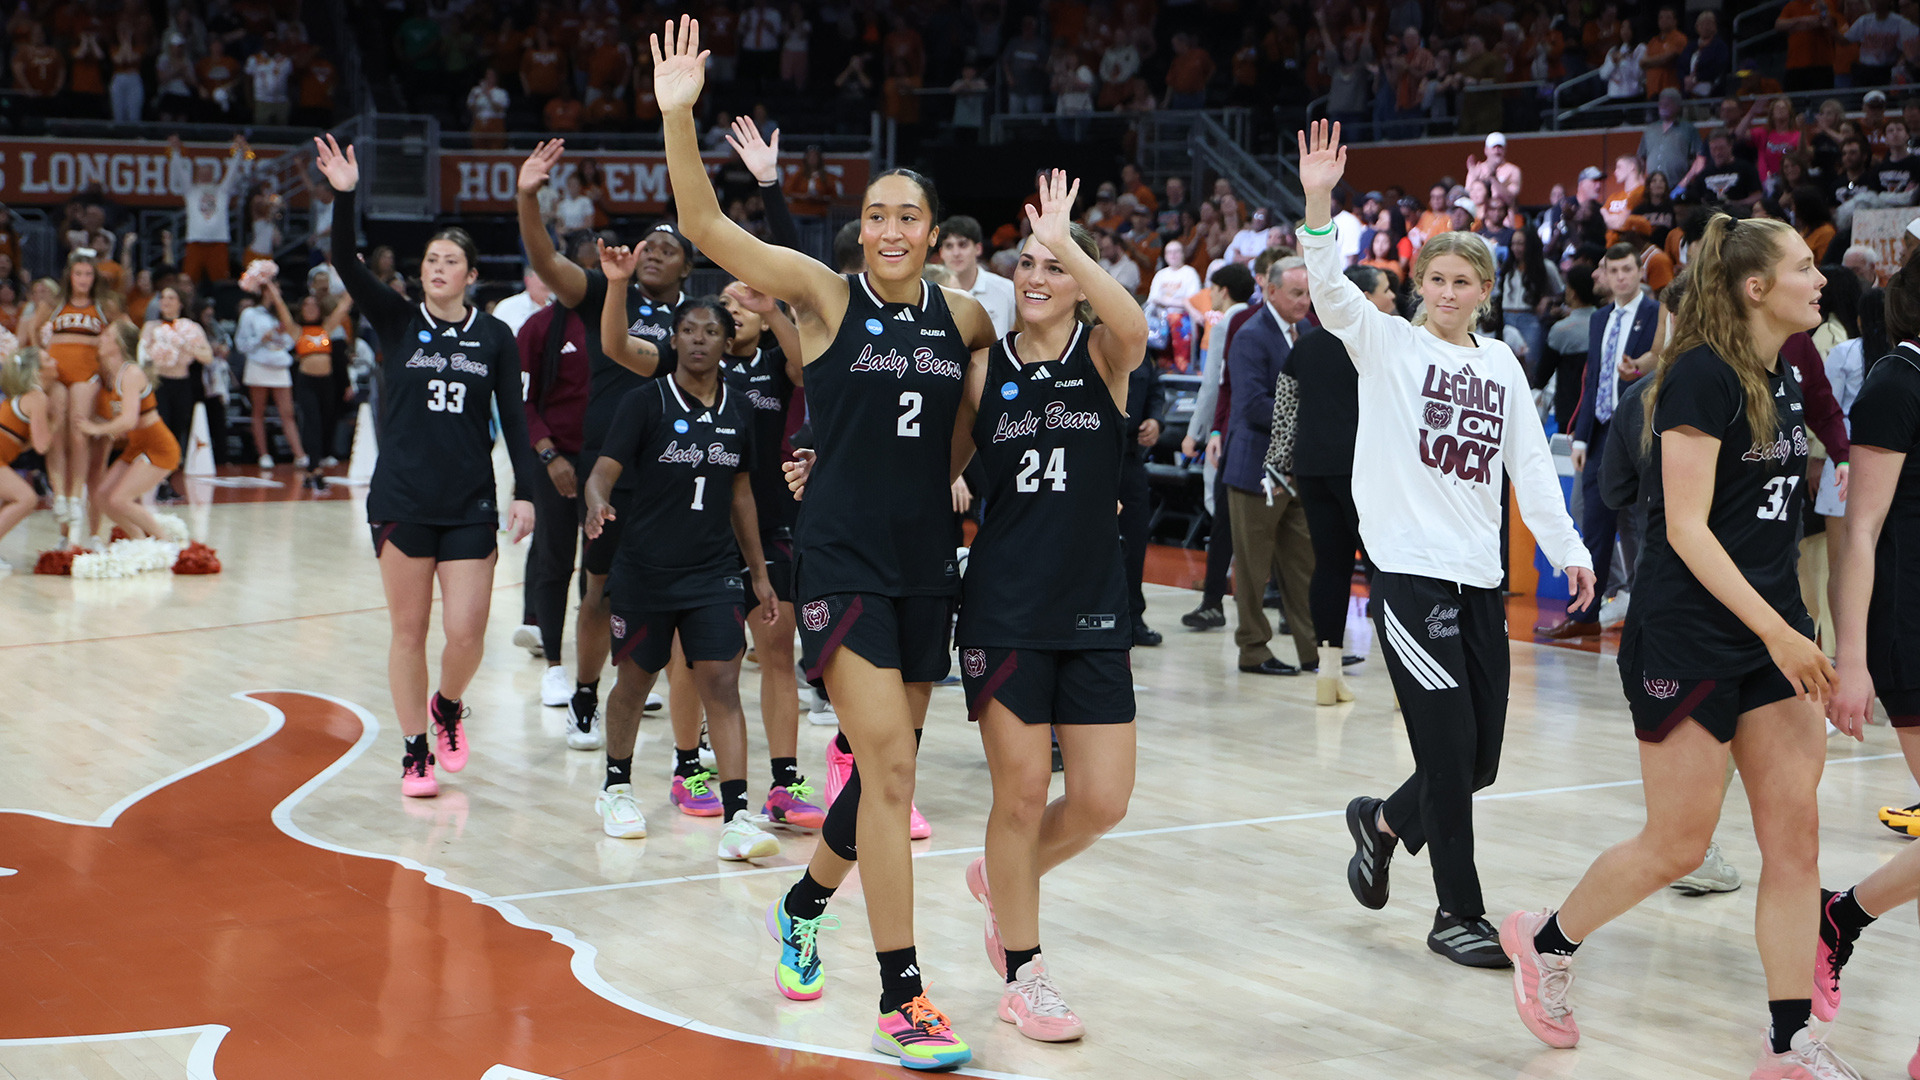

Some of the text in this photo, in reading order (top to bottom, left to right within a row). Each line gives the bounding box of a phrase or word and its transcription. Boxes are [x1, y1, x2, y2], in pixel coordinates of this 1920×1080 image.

[457, 161, 577, 201] HOK
[54, 313, 102, 334] TEXAS
[628, 319, 667, 341] Lady
[405, 347, 489, 378] Lady Bears
[850, 343, 962, 380] Lady Bears
[427, 378, 467, 414] 33
[1421, 364, 1506, 416] LEGACY
[897, 390, 923, 437] 2
[993, 400, 1101, 444] Lady Bears
[1465, 420, 1500, 438] ON
[658, 440, 704, 469] Lady
[1419, 429, 1499, 485] LOCK
[1741, 431, 1791, 466] Lady
[1016, 447, 1068, 493] 24
[690, 475, 706, 511] 1
